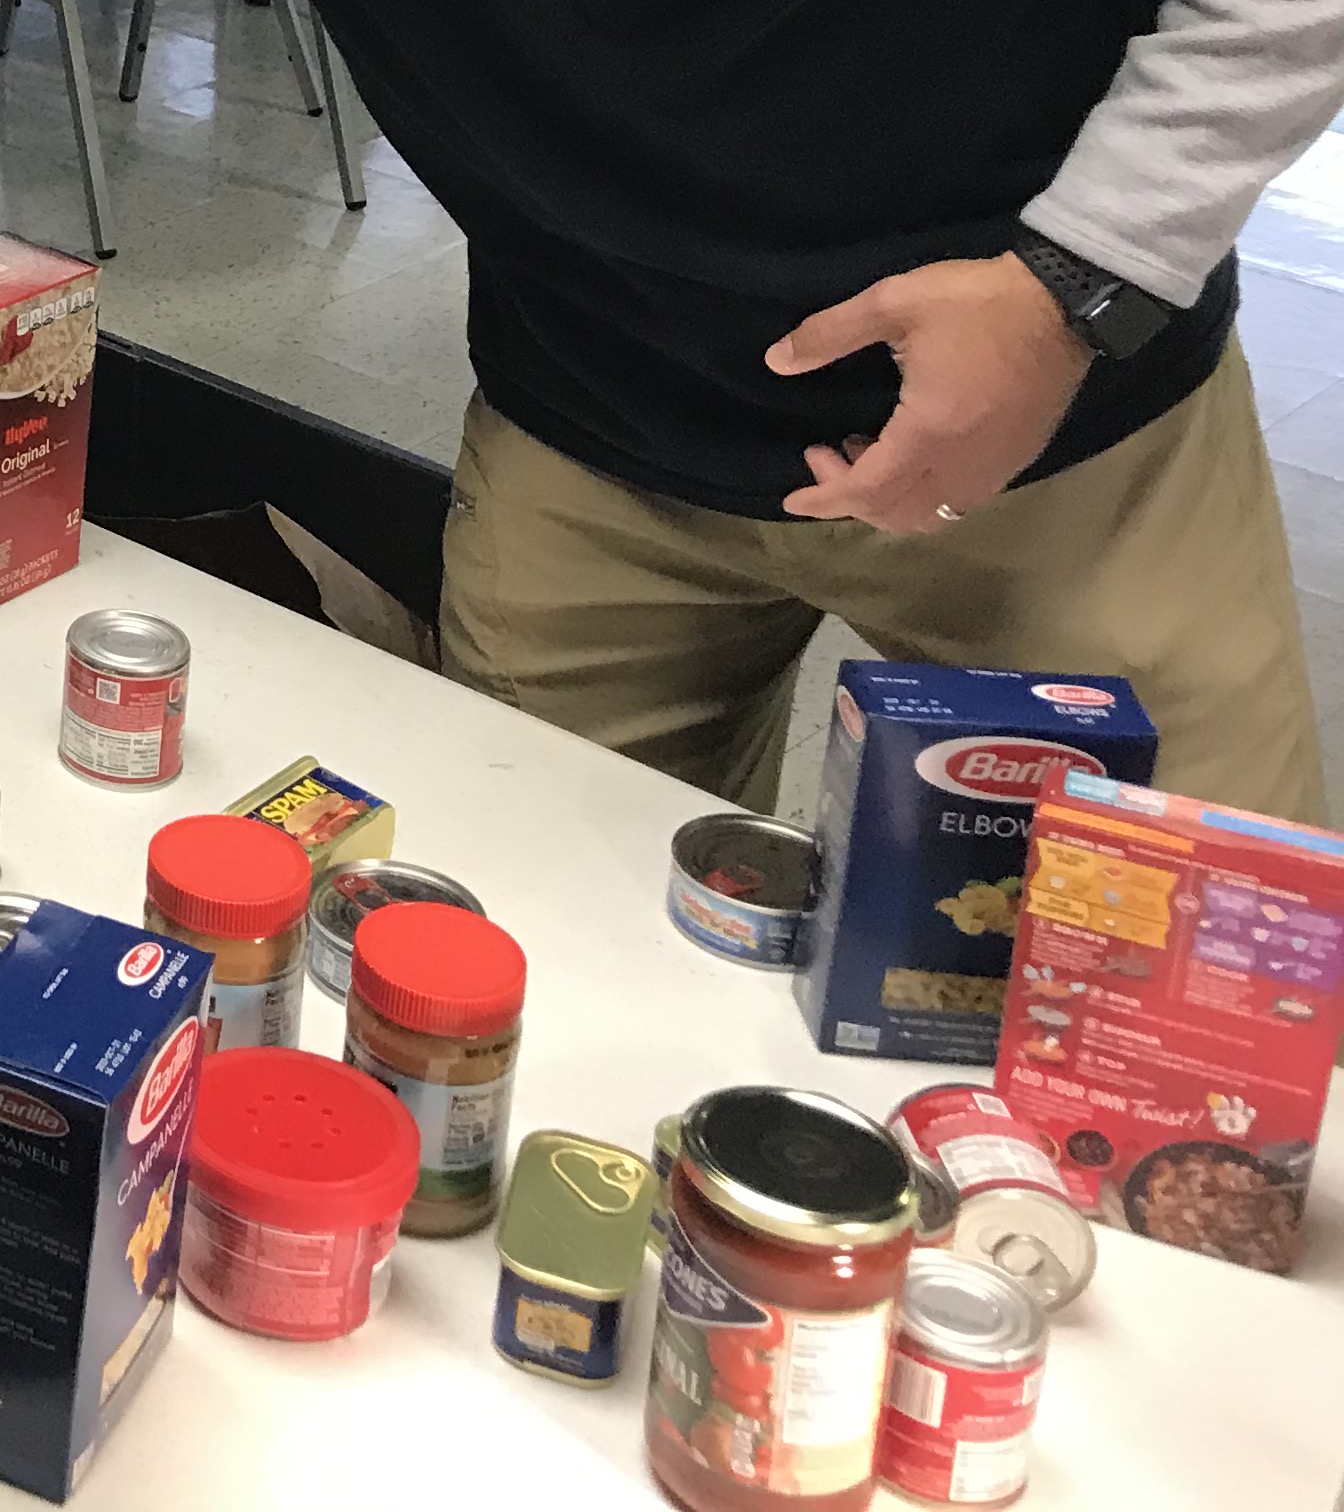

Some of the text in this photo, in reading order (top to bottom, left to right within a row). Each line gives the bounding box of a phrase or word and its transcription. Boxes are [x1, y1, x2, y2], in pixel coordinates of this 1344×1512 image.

[0, 438, 51, 475] Original
[65, 507, 81, 529] 12
[960, 752, 1089, 785] Bari
[260, 778, 330, 825] SPAM
[938, 810, 1032, 838] ELBO
[127, 944, 158, 977] Barilla
[148, 950, 190, 1000] CAMPANELLE
[144, 1029, 196, 1118] Barilla
[116, 1075, 195, 1207] CAMPANELLE
